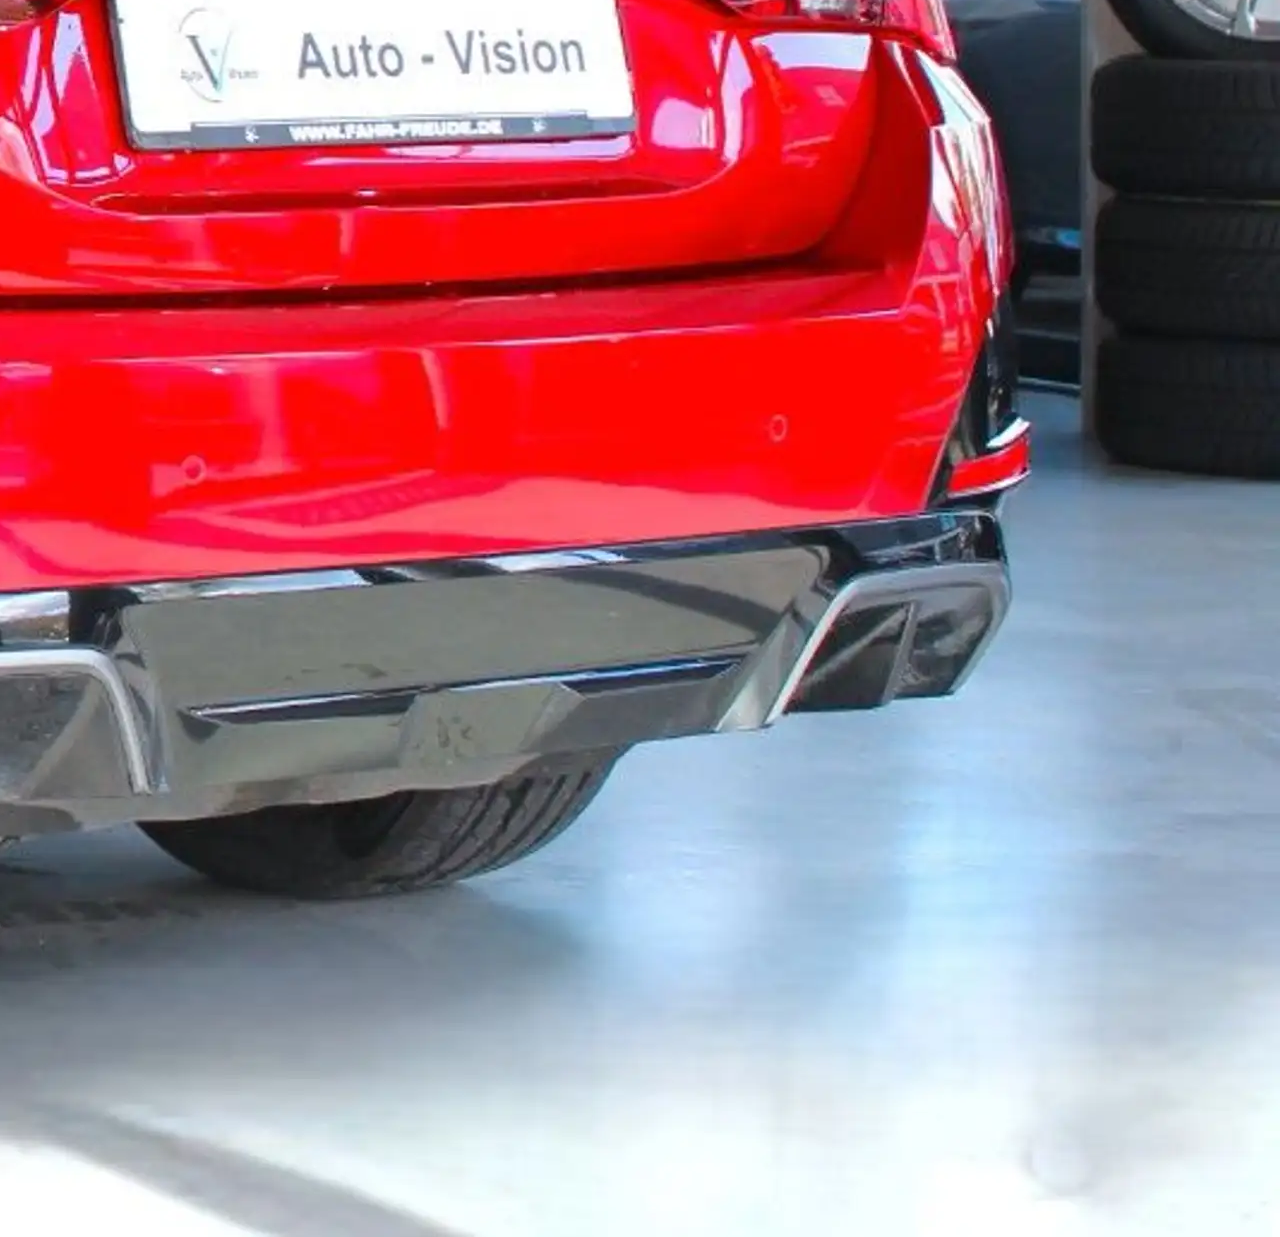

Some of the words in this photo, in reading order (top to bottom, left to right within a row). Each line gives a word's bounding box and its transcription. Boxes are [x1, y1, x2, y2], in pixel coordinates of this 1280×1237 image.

[297, 31, 405, 79] Auto
[420, 53, 435, 65] -
[444, 28, 588, 75] Vision
[289, 119, 504, 142] WWW.FAHR-FREUDE.DE
